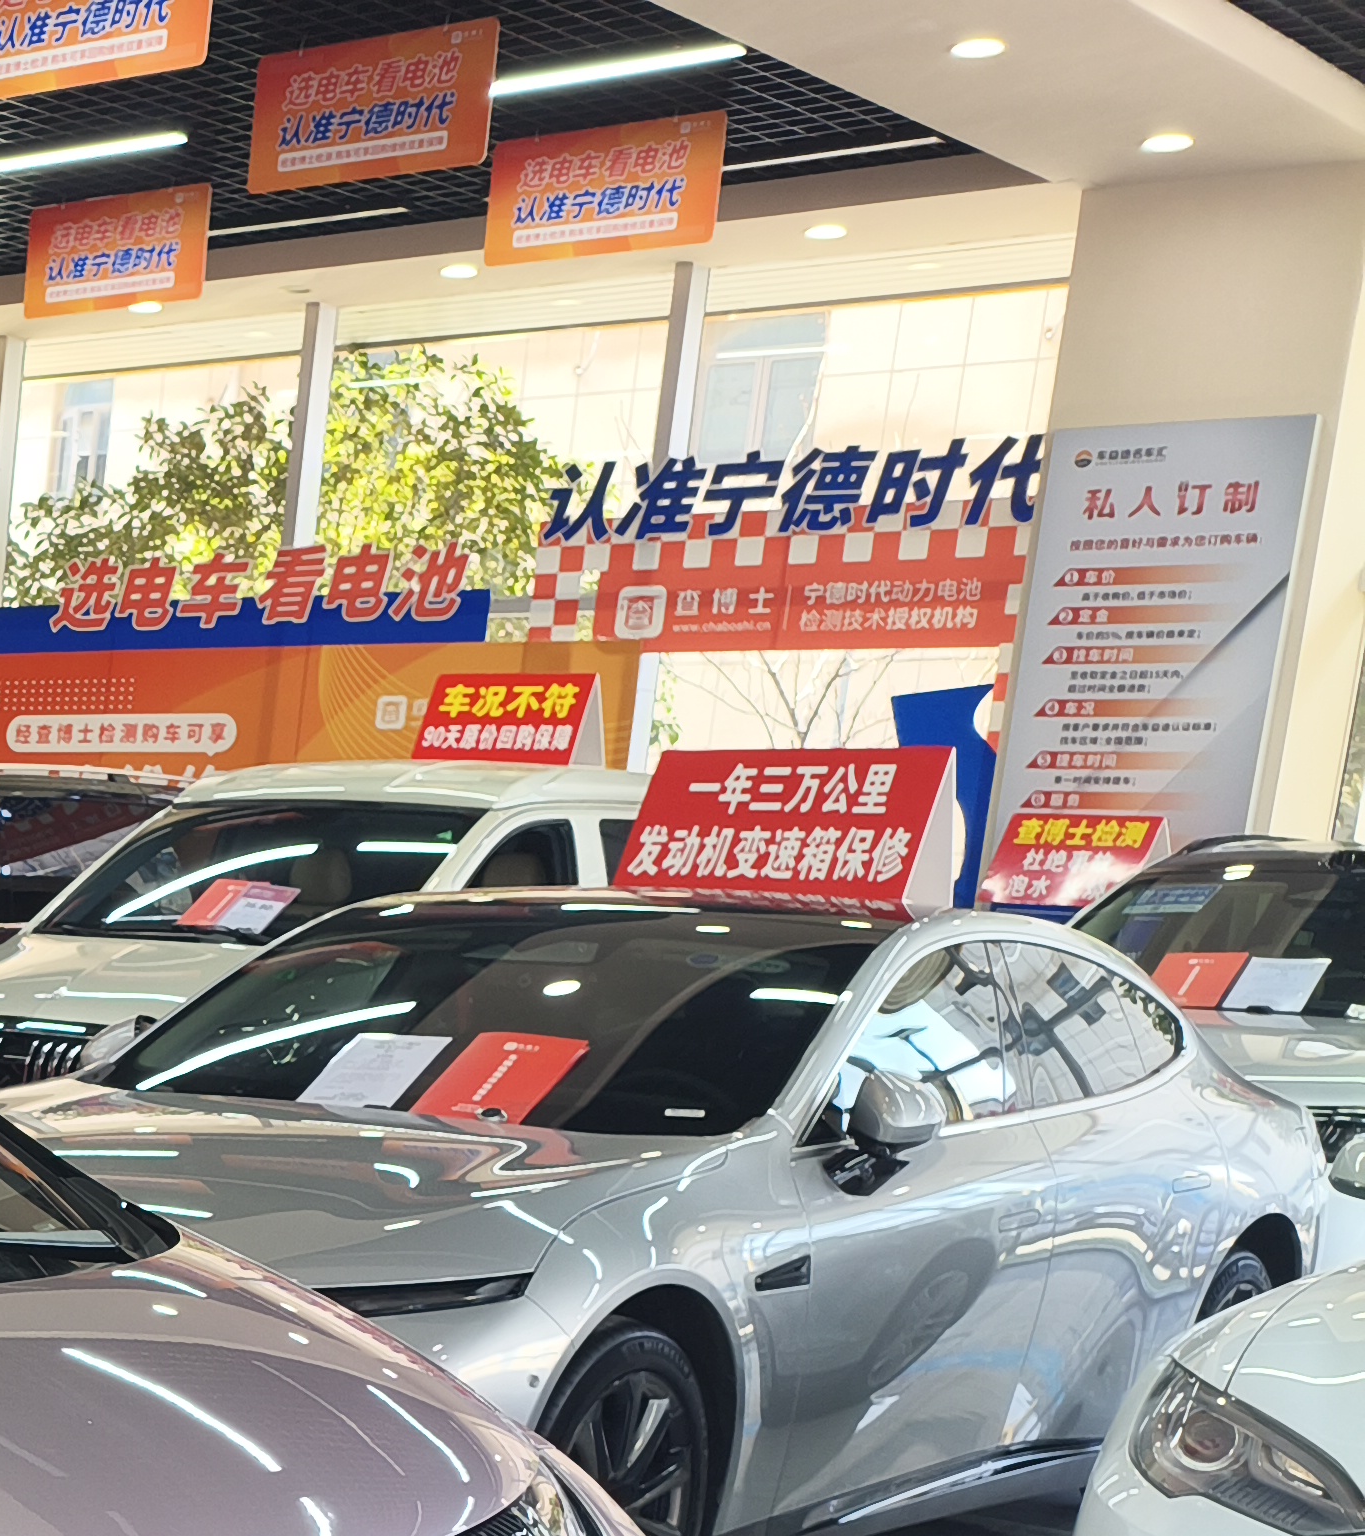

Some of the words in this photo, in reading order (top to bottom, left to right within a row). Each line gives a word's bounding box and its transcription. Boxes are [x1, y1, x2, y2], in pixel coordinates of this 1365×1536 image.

[278, 92, 456, 149] 认准宁德时代
[512, 178, 685, 227] 认准宁德时代
[44, 241, 181, 284] 认准宁德时代
[541, 434, 1045, 542] 认准宁德时代
[1082, 480, 1260, 521] 私人订制
[49, 540, 471, 634] 选电车看电池
[804, 577, 982, 606] 宁德时代动力电池
[799, 606, 979, 633] 检测技术授权机构
[438, 683, 580, 719] 车况不符
[688, 762, 898, 815] 一年三万公里
[626, 824, 913, 883] 发动机变速箱保修
[1013, 817, 1150, 848] 查博士检测
